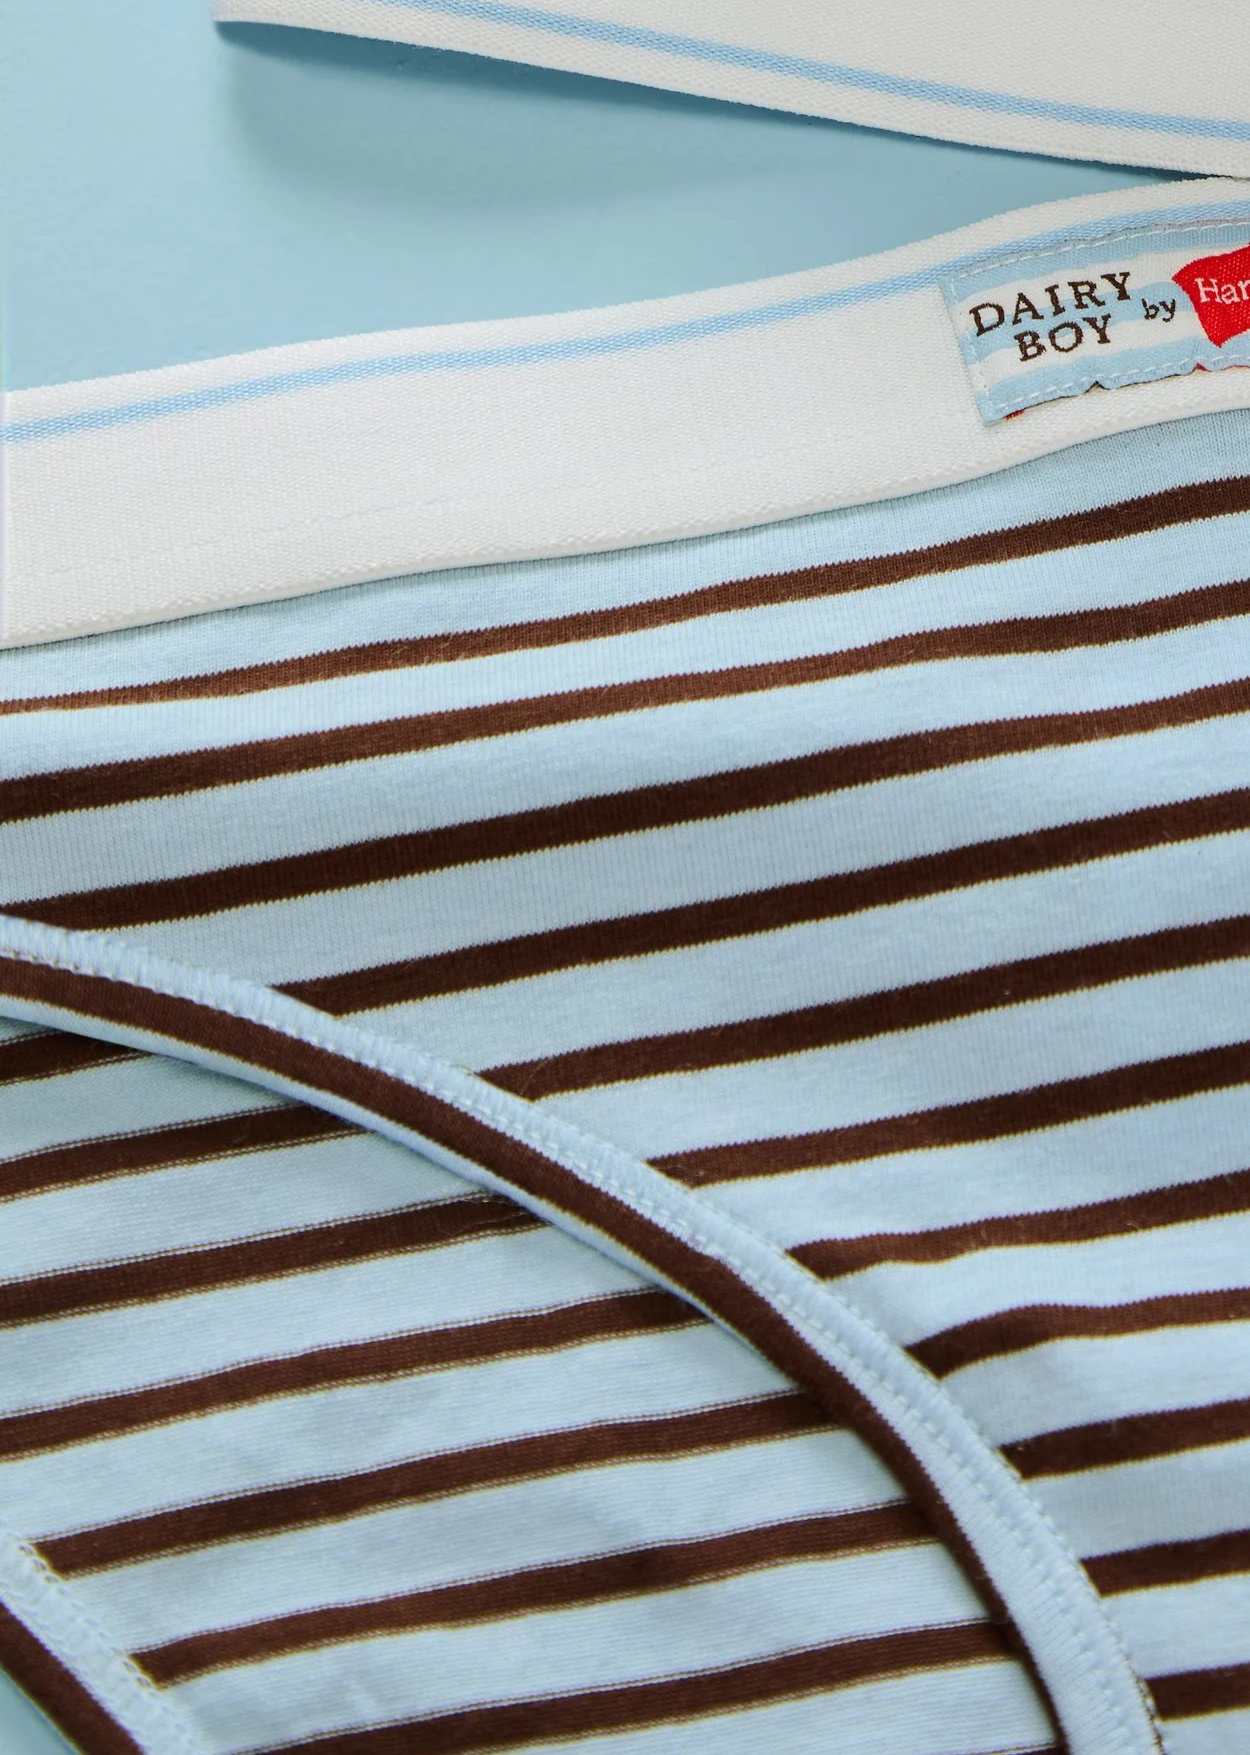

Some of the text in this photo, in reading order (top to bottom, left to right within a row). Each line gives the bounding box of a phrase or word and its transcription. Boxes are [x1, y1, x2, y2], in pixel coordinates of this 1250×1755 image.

[969, 271, 1131, 337] DAIRY
[1014, 313, 1111, 362] BOY
[1142, 298, 1177, 323] by
